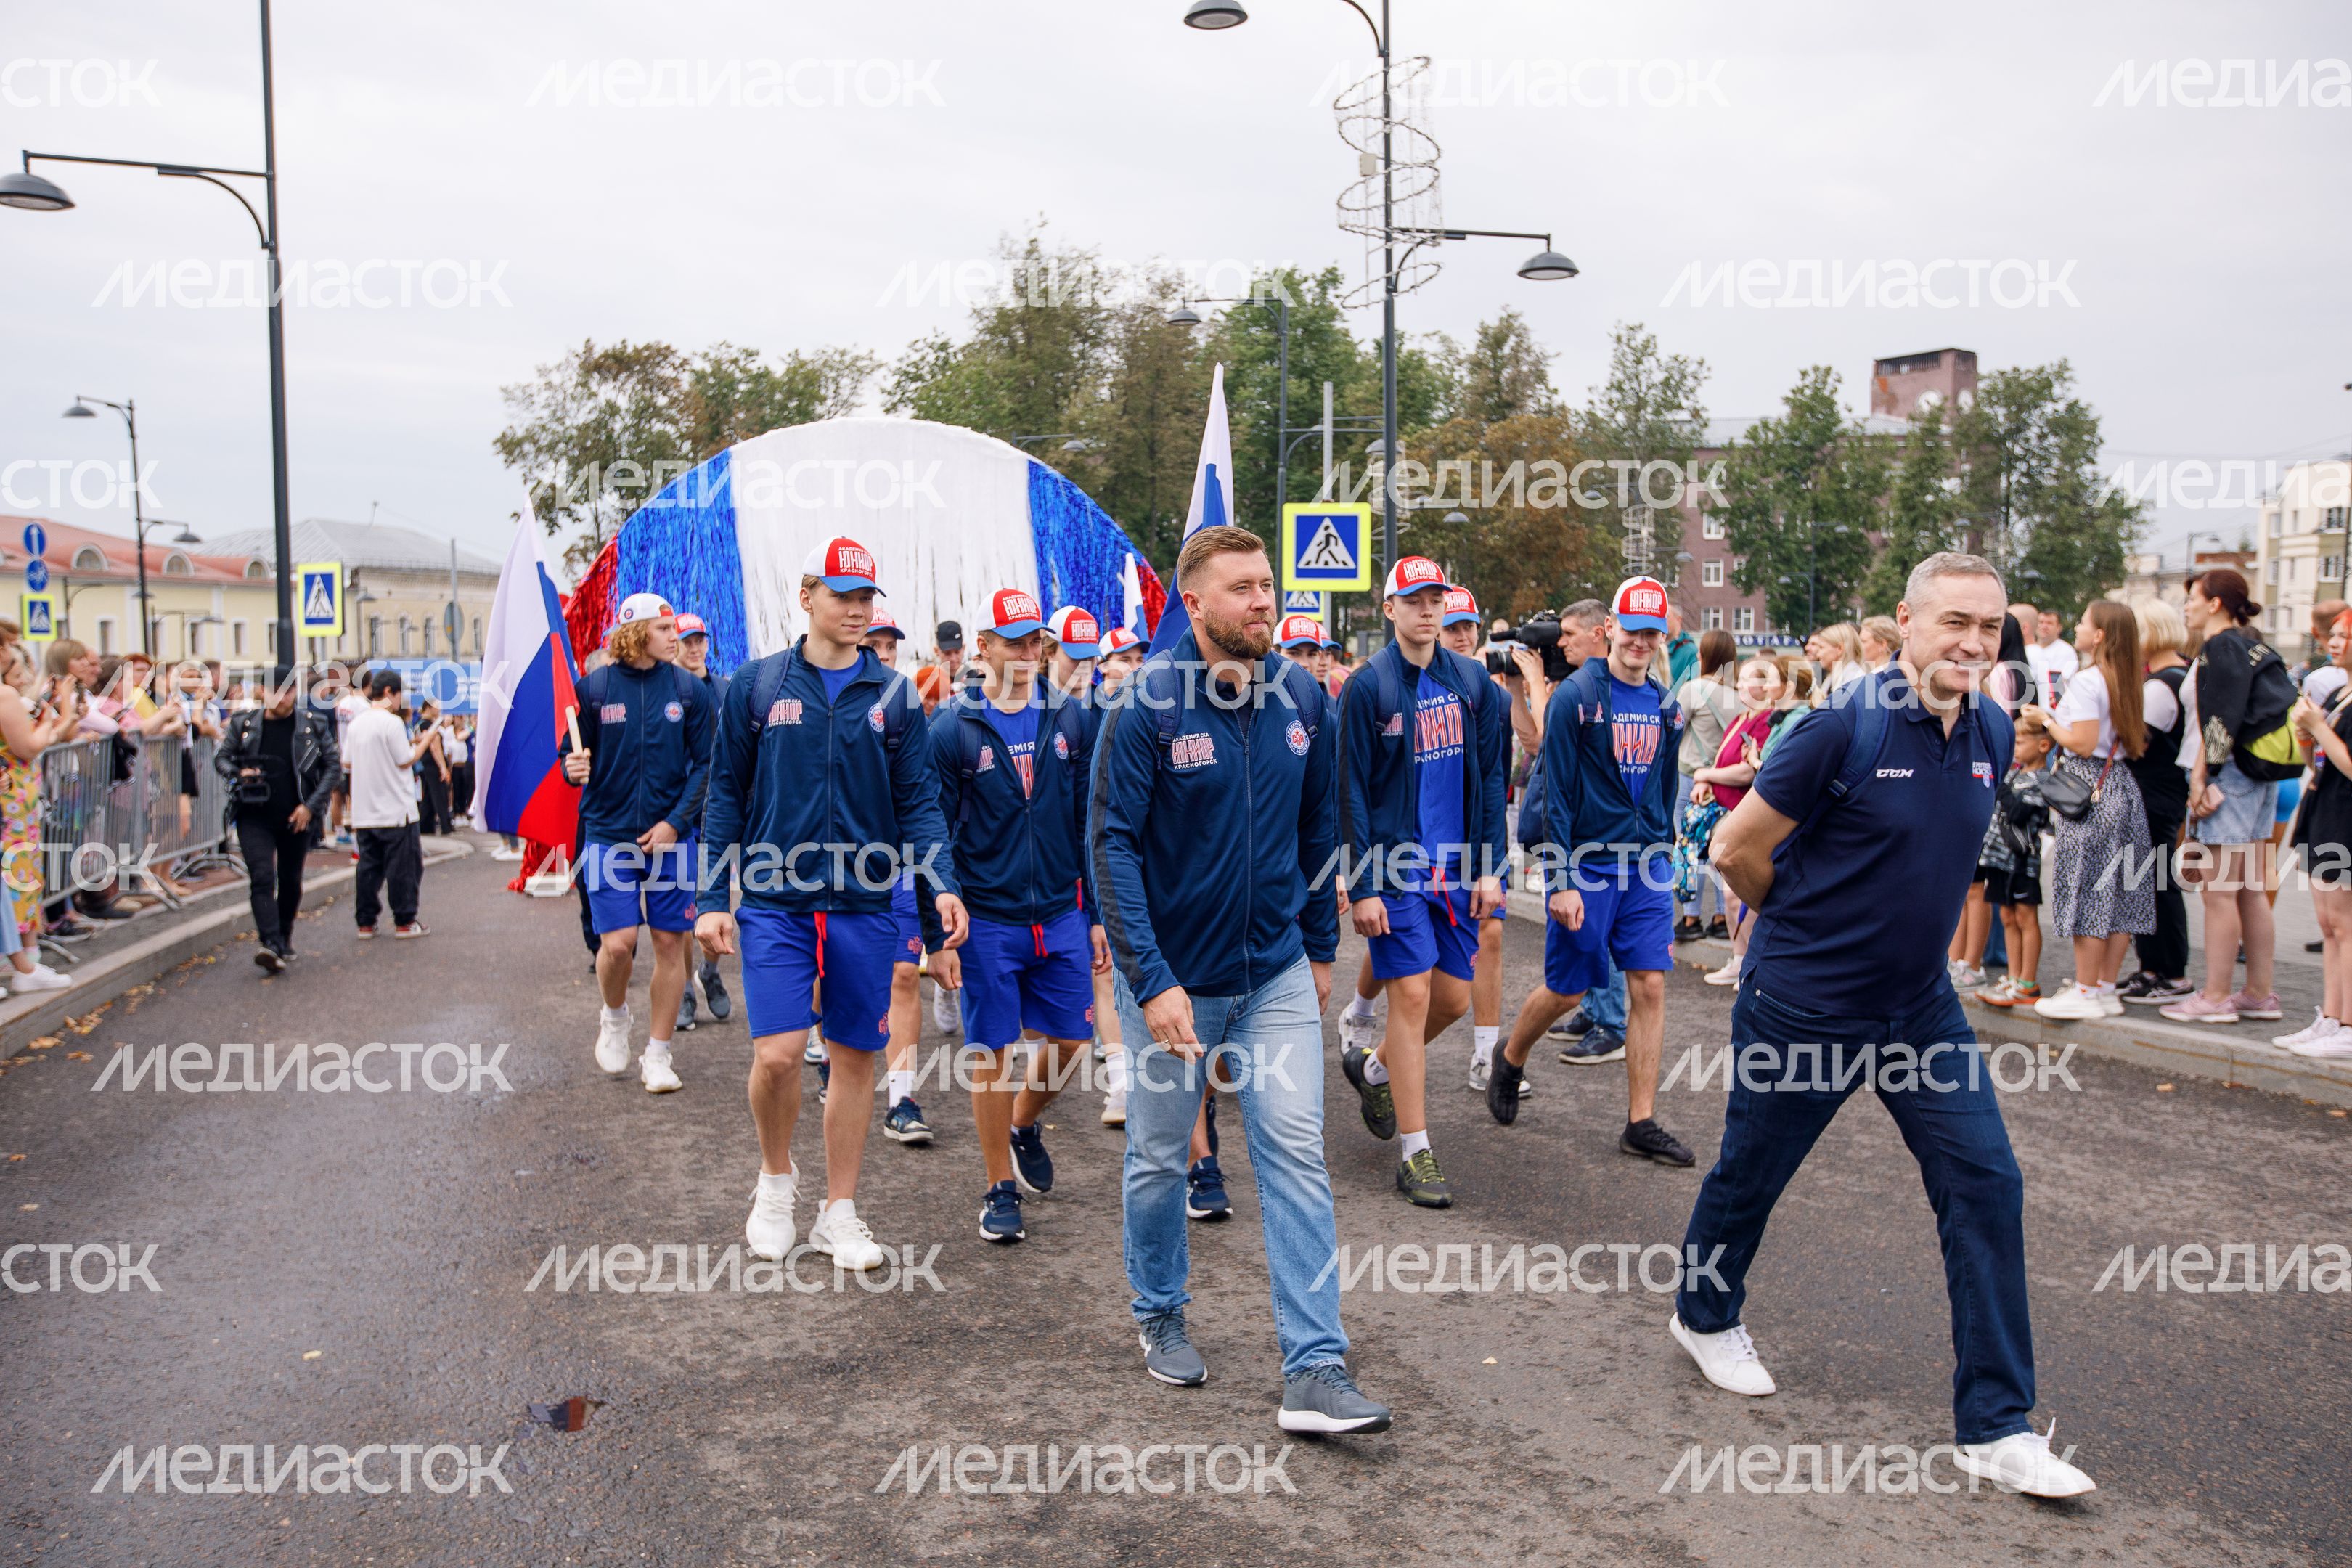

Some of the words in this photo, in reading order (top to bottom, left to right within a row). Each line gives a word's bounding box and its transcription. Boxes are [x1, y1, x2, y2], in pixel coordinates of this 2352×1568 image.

[1630, 592, 1662, 611] ЮНИОР
[1172, 733, 1199, 743] АКАДЕМИЯ
[1171, 737, 1214, 764] ЮНИОР
[1174, 759, 1217, 770] КРАСНОГОРСК
[1876, 769, 1914, 778] CCM
